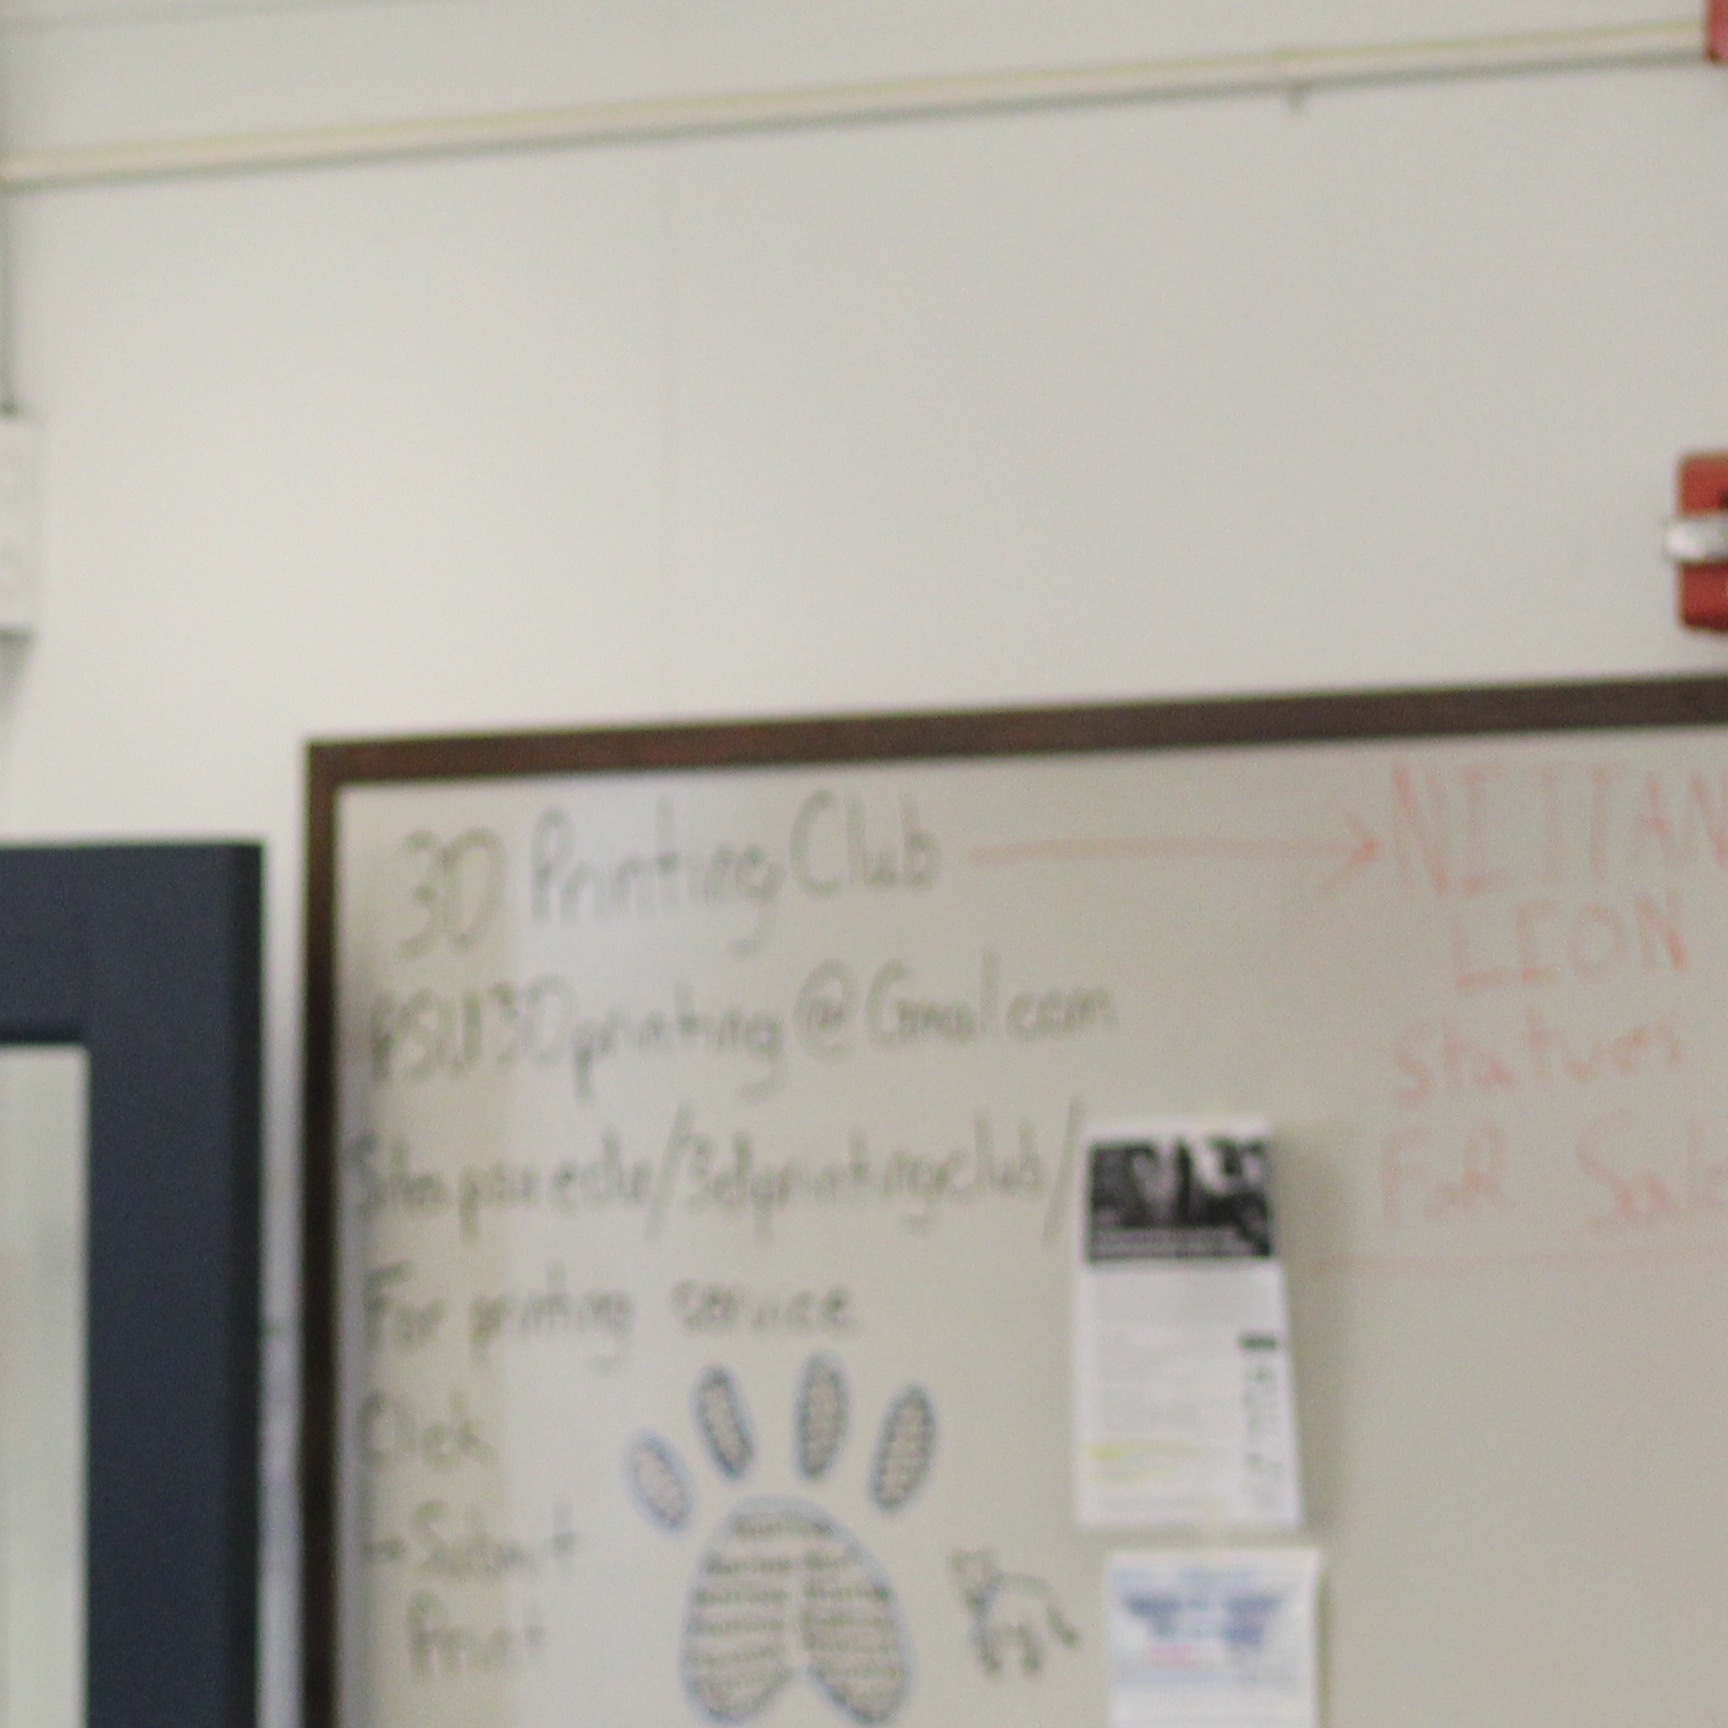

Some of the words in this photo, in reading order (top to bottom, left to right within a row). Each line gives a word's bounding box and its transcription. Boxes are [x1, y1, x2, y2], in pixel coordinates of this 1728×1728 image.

[394, 825, 510, 962] 3D
[527, 802, 792, 960] Printing
[788, 786, 944, 898] Club
[1448, 892, 1690, 998] LION
[362, 1262, 446, 1350] For
[468, 1262, 636, 1371] printing
[405, 1594, 546, 1682] Print
